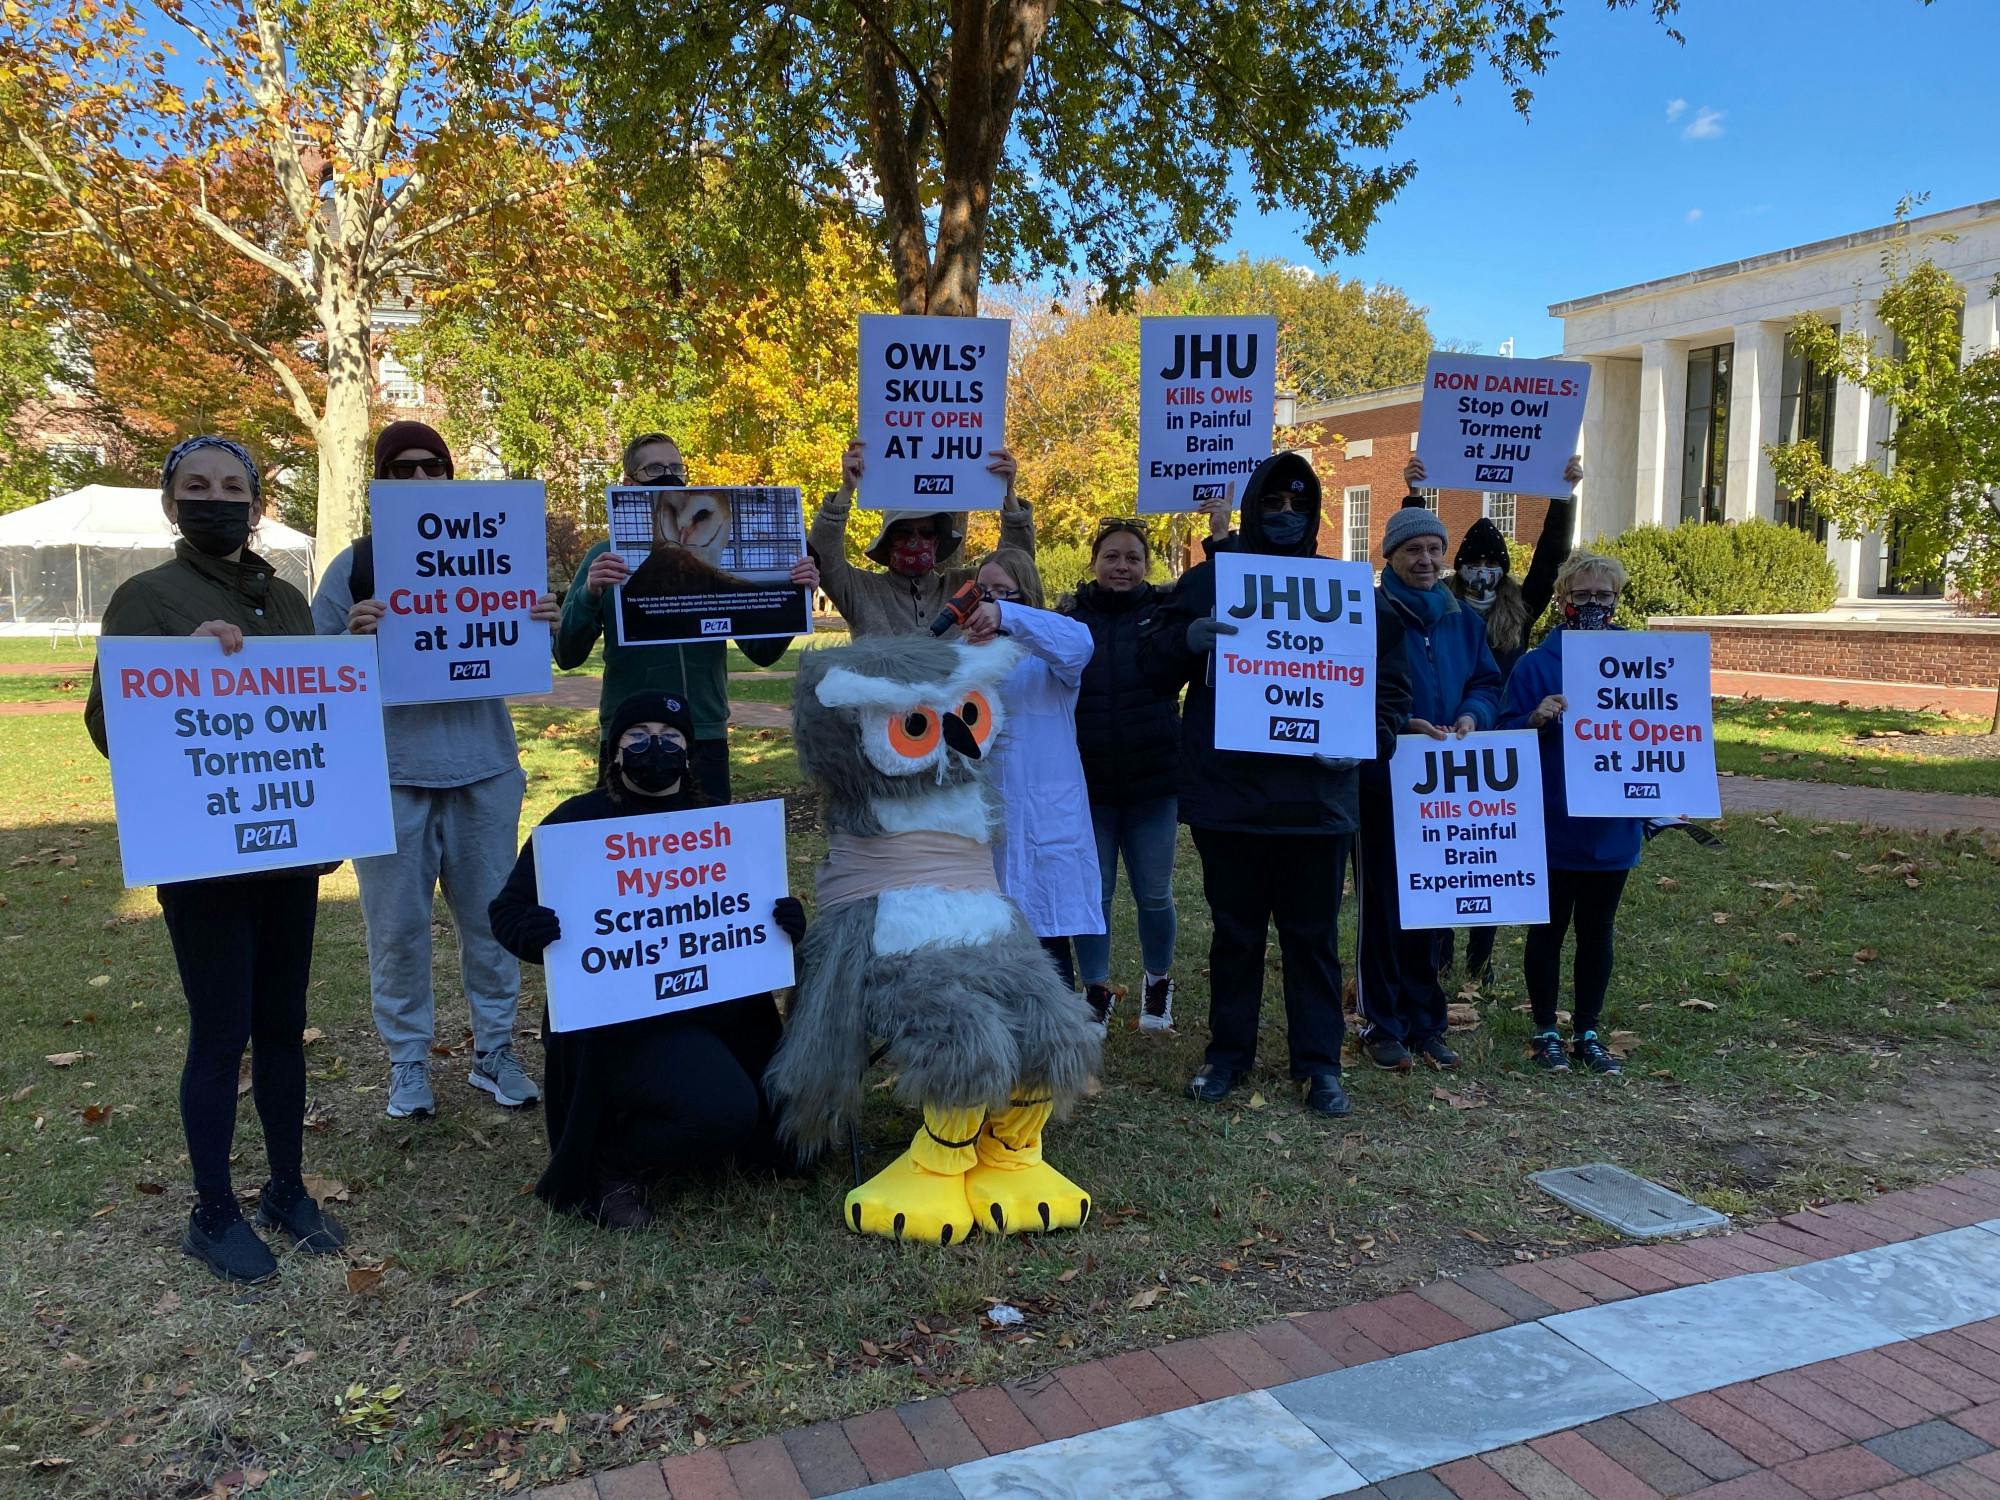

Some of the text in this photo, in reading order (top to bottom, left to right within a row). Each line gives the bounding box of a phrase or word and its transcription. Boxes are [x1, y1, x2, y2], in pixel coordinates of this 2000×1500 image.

[885, 343, 985, 371] OWLS’
[1160, 334, 1257, 380] JHU
[885, 379, 983, 403] SKULLS
[1167, 386, 1252, 405] Kills Owls
[1434, 373, 1578, 396] RON DANIELS:
[1458, 397, 1548, 417] Stop Owl
[885, 411, 982, 428] CUT OPEN
[1167, 410, 1250, 429] in Painful
[1460, 419, 1542, 439] Torment
[885, 436, 982, 459] AT JHU
[1187, 434, 1233, 452] Brain
[1464, 443, 1530, 461] at JHU
[418, 512, 505, 540] Owls’
[416, 549, 511, 577] Skulls
[390, 586, 536, 616] Cut Open
[1228, 574, 1362, 624] JHU:
[415, 621, 518, 651] at JHU
[1267, 630, 1323, 654] Stop
[1224, 654, 1364, 686] Tormenting
[1600, 657, 1674, 679] Owls’
[121, 666, 366, 698] RON DANIELS:
[1265, 684, 1323, 708] Owls
[1597, 688, 1678, 710] Skulls
[175, 703, 326, 740] Stop Owl
[1575, 719, 1701, 745] Cut Open
[184, 743, 325, 776] Torment
[1413, 748, 1518, 794] JHU
[1595, 751, 1685, 772] at JHU
[207, 780, 314, 815] at JHU
[1421, 799, 1516, 818] Kills Owls
[605, 822, 730, 860] Shreesh
[1423, 822, 1516, 842] in Painful
[1445, 847, 1496, 865] Brain
[616, 862, 726, 897] Mysore
[1410, 870, 1535, 892] Experiments
[594, 892, 750, 936] Scrambles
[582, 924, 766, 974] Owls’ Brains
